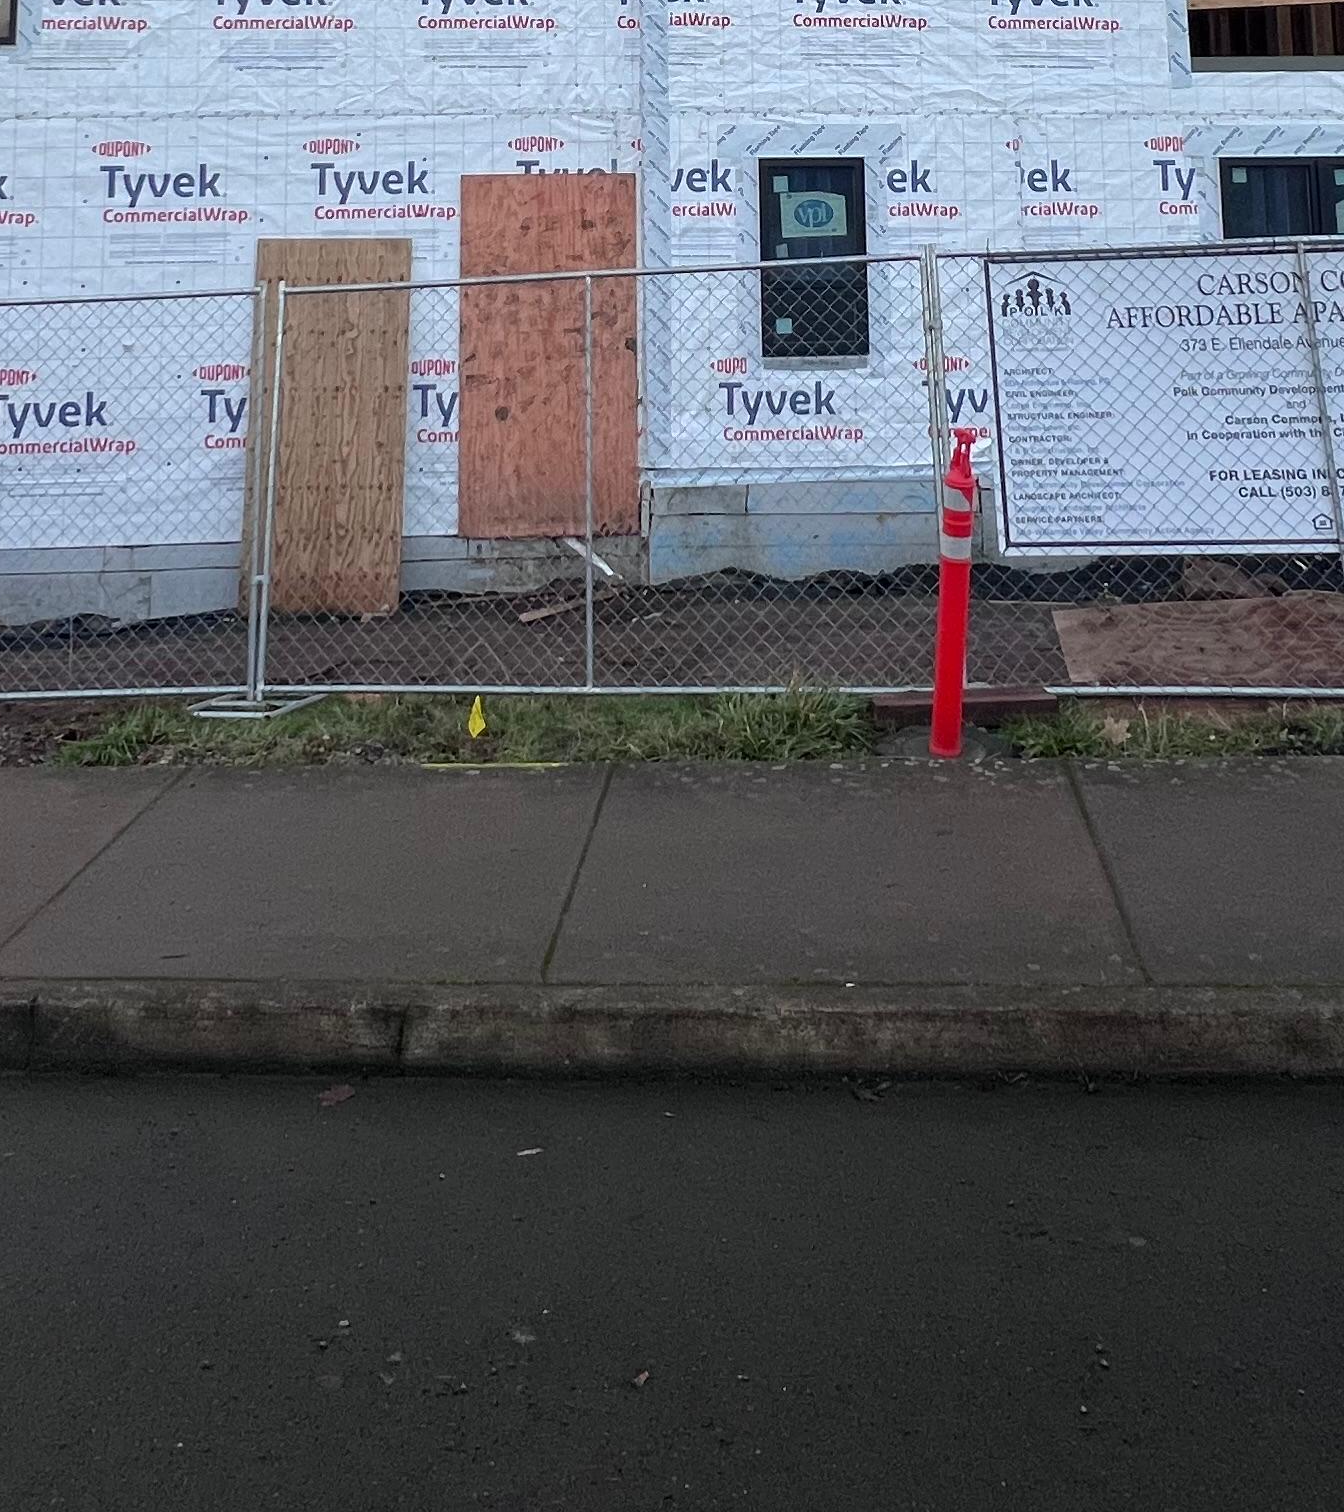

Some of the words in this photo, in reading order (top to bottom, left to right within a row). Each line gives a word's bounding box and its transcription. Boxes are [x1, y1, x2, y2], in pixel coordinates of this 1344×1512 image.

[101, 165, 220, 208] Tyvek
[311, 161, 429, 204] Tyvek
[1197, 271, 1310, 296] CARSON
[1107, 303, 1284, 328] AFFORDABLE
[1180, 338, 1207, 352] 373
[1229, 336, 1292, 351] Ellendale
[1174, 387, 1198, 397] Polk
[1201, 386, 1266, 397] Community
[1225, 415, 1267, 425] Carson
[1187, 431, 1198, 440] In
[1202, 429, 1275, 441] Cooperation
[1279, 428, 1306, 439] with
[1310, 428, 1328, 438] th
[1209, 470, 1239, 481] FOR
[1243, 469, 1306, 481] LEASING
[1238, 487, 1276, 498] CALL
[1281, 487, 1317, 499] (503)
